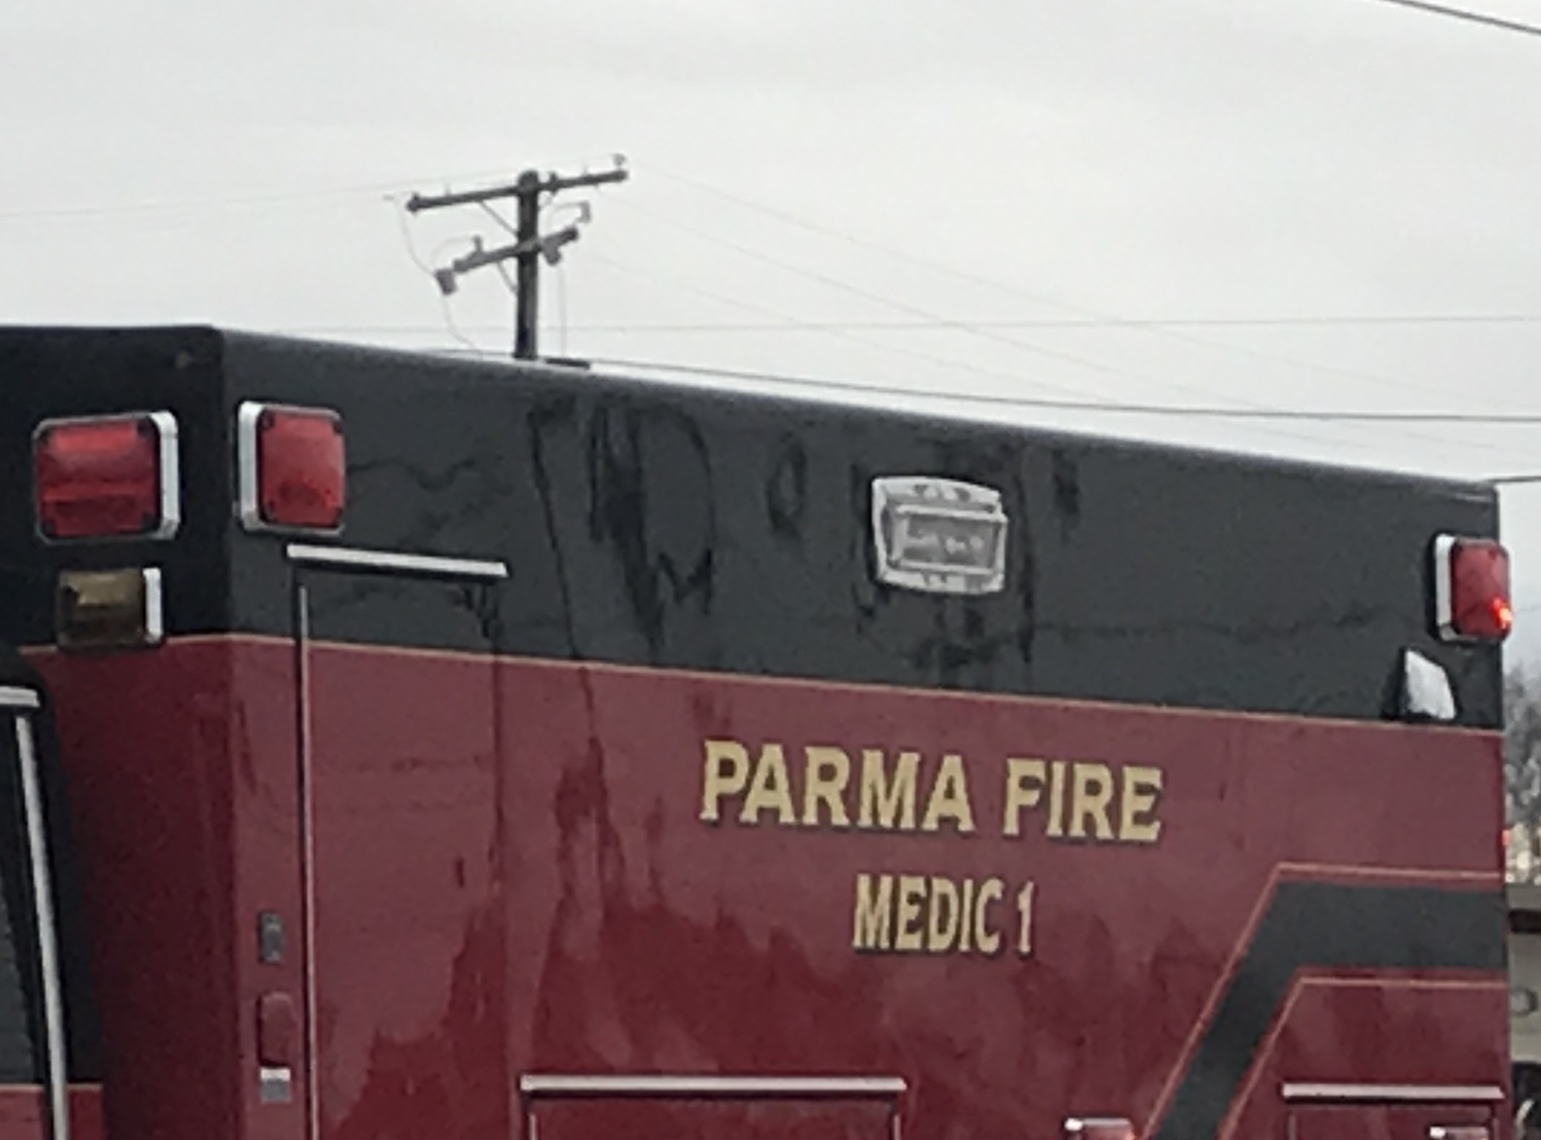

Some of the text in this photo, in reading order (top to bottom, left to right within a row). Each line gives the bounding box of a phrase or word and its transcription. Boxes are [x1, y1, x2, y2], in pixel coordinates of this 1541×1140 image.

[698, 739, 1164, 842] PARMA FIRE
[852, 873, 1038, 955] MEDIC 1
